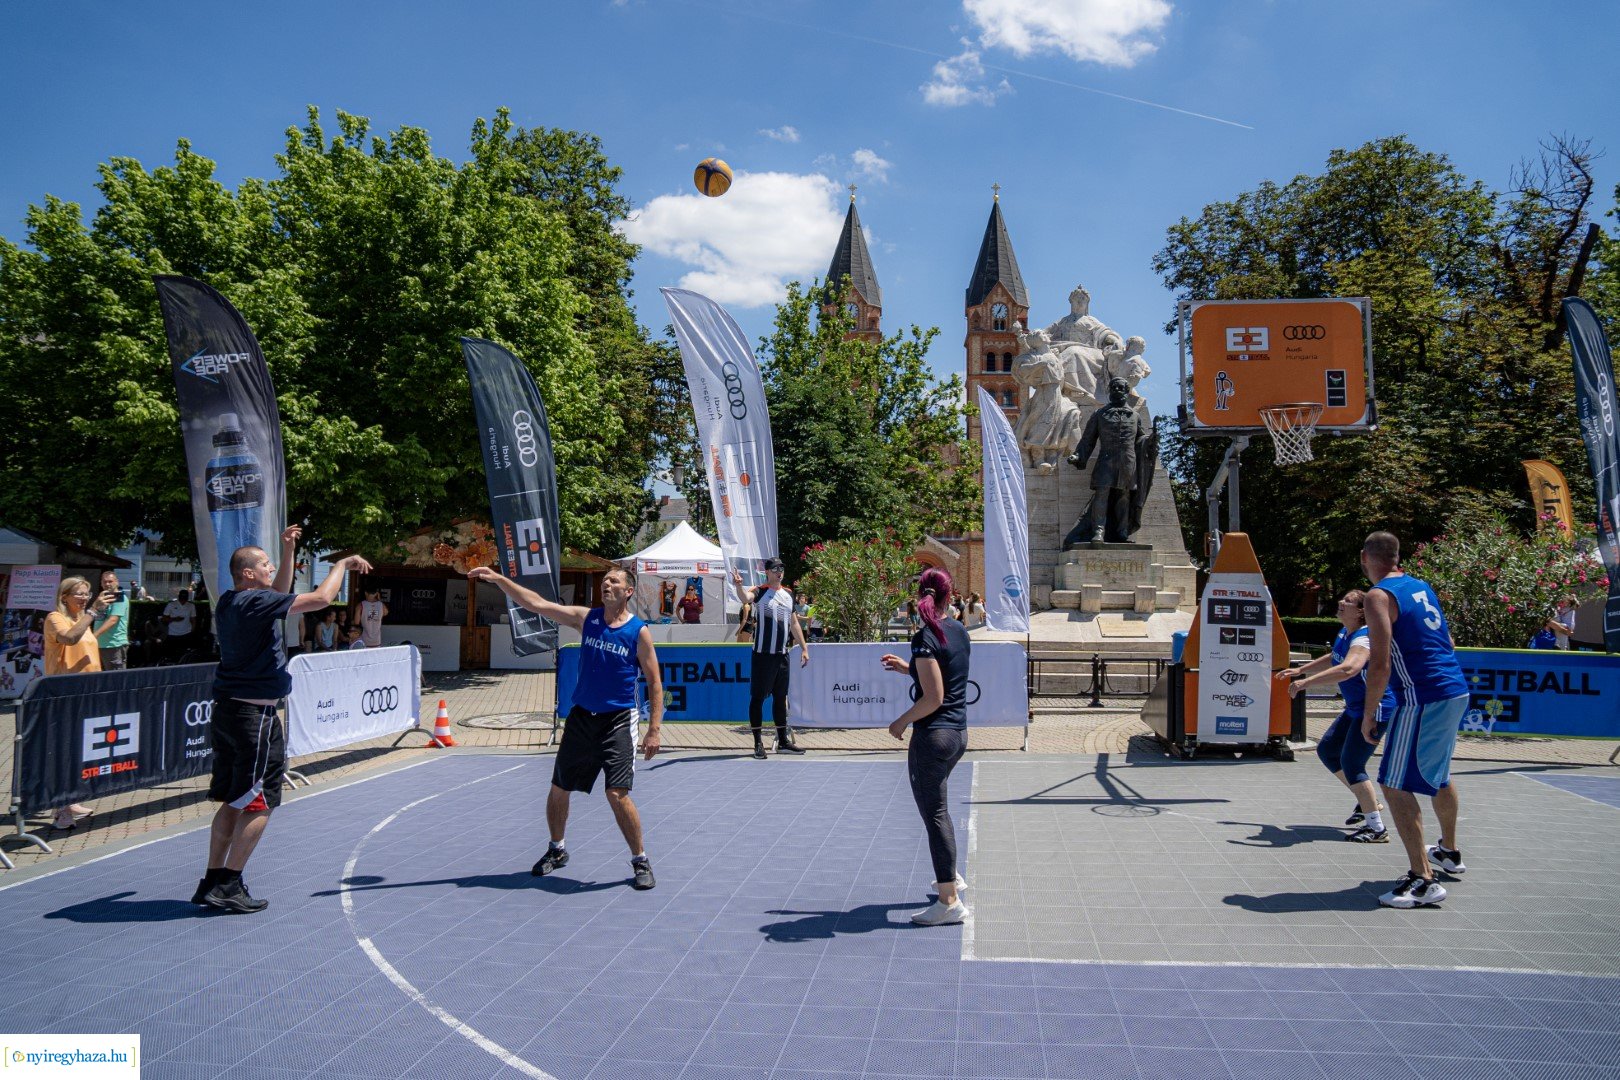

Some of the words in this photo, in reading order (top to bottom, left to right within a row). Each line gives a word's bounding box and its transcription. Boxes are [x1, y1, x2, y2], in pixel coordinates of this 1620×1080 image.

[1086, 561, 1145, 573] KOSSUTH
[1212, 589, 1261, 598] STREETBALL
[1412, 590, 1441, 631] 3
[585, 636, 630, 657] MICHELIN
[832, 683, 860, 692] Audi
[317, 698, 334, 709] Audi
[833, 695, 886, 706] Hungaria
[316, 711, 349, 723] Hungaria
[186, 736, 205, 746] Audi
[185, 748, 213, 759] Hungar
[82, 760, 138, 779] STREETBALL
